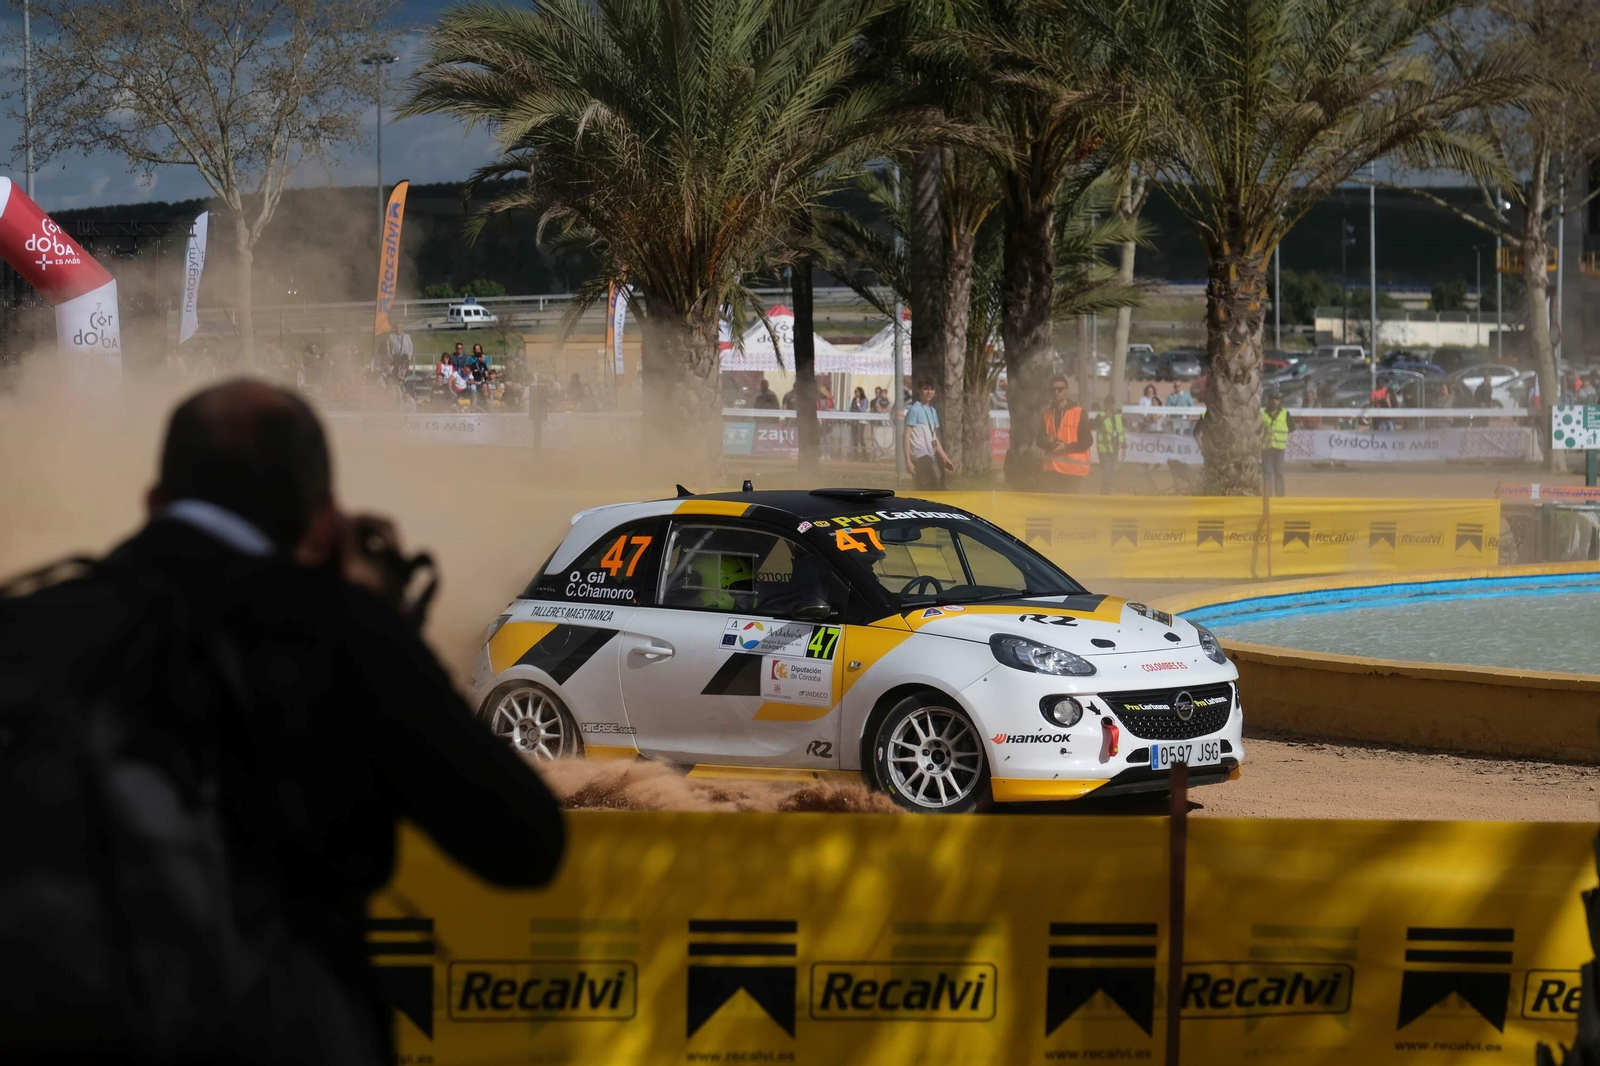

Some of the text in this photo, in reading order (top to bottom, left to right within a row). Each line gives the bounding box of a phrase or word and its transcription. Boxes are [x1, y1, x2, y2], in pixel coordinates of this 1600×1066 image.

[381, 220, 399, 295] Recalvi
[830, 514, 881, 527] Pro
[876, 510, 971, 521] Carbono
[835, 528, 886, 553] 47
[1143, 531, 1183, 542] Recalvi
[1315, 533, 1355, 543] Recalvi
[1400, 534, 1441, 545] Recalvi
[601, 534, 653, 577] 47
[587, 571, 606, 584] Gil
[566, 583, 634, 600] C.Chamorro
[531, 606, 614, 622] TALLERES MAESTRANZA
[1018, 613, 1079, 627] R2
[808, 626, 841, 659] 47
[790, 665, 822, 675] Diputación
[798, 674, 821, 682] Córdoba
[806, 740, 833, 759] R2
[1161, 744, 1192, 766] 0597
[1198, 742, 1219, 762] JSG
[459, 971, 626, 1011] Recalvi
[819, 971, 988, 1011] Recalvi
[1180, 971, 1342, 1010] Recalvi
[1393, 1040, 1503, 1053] www.recalvi.es
